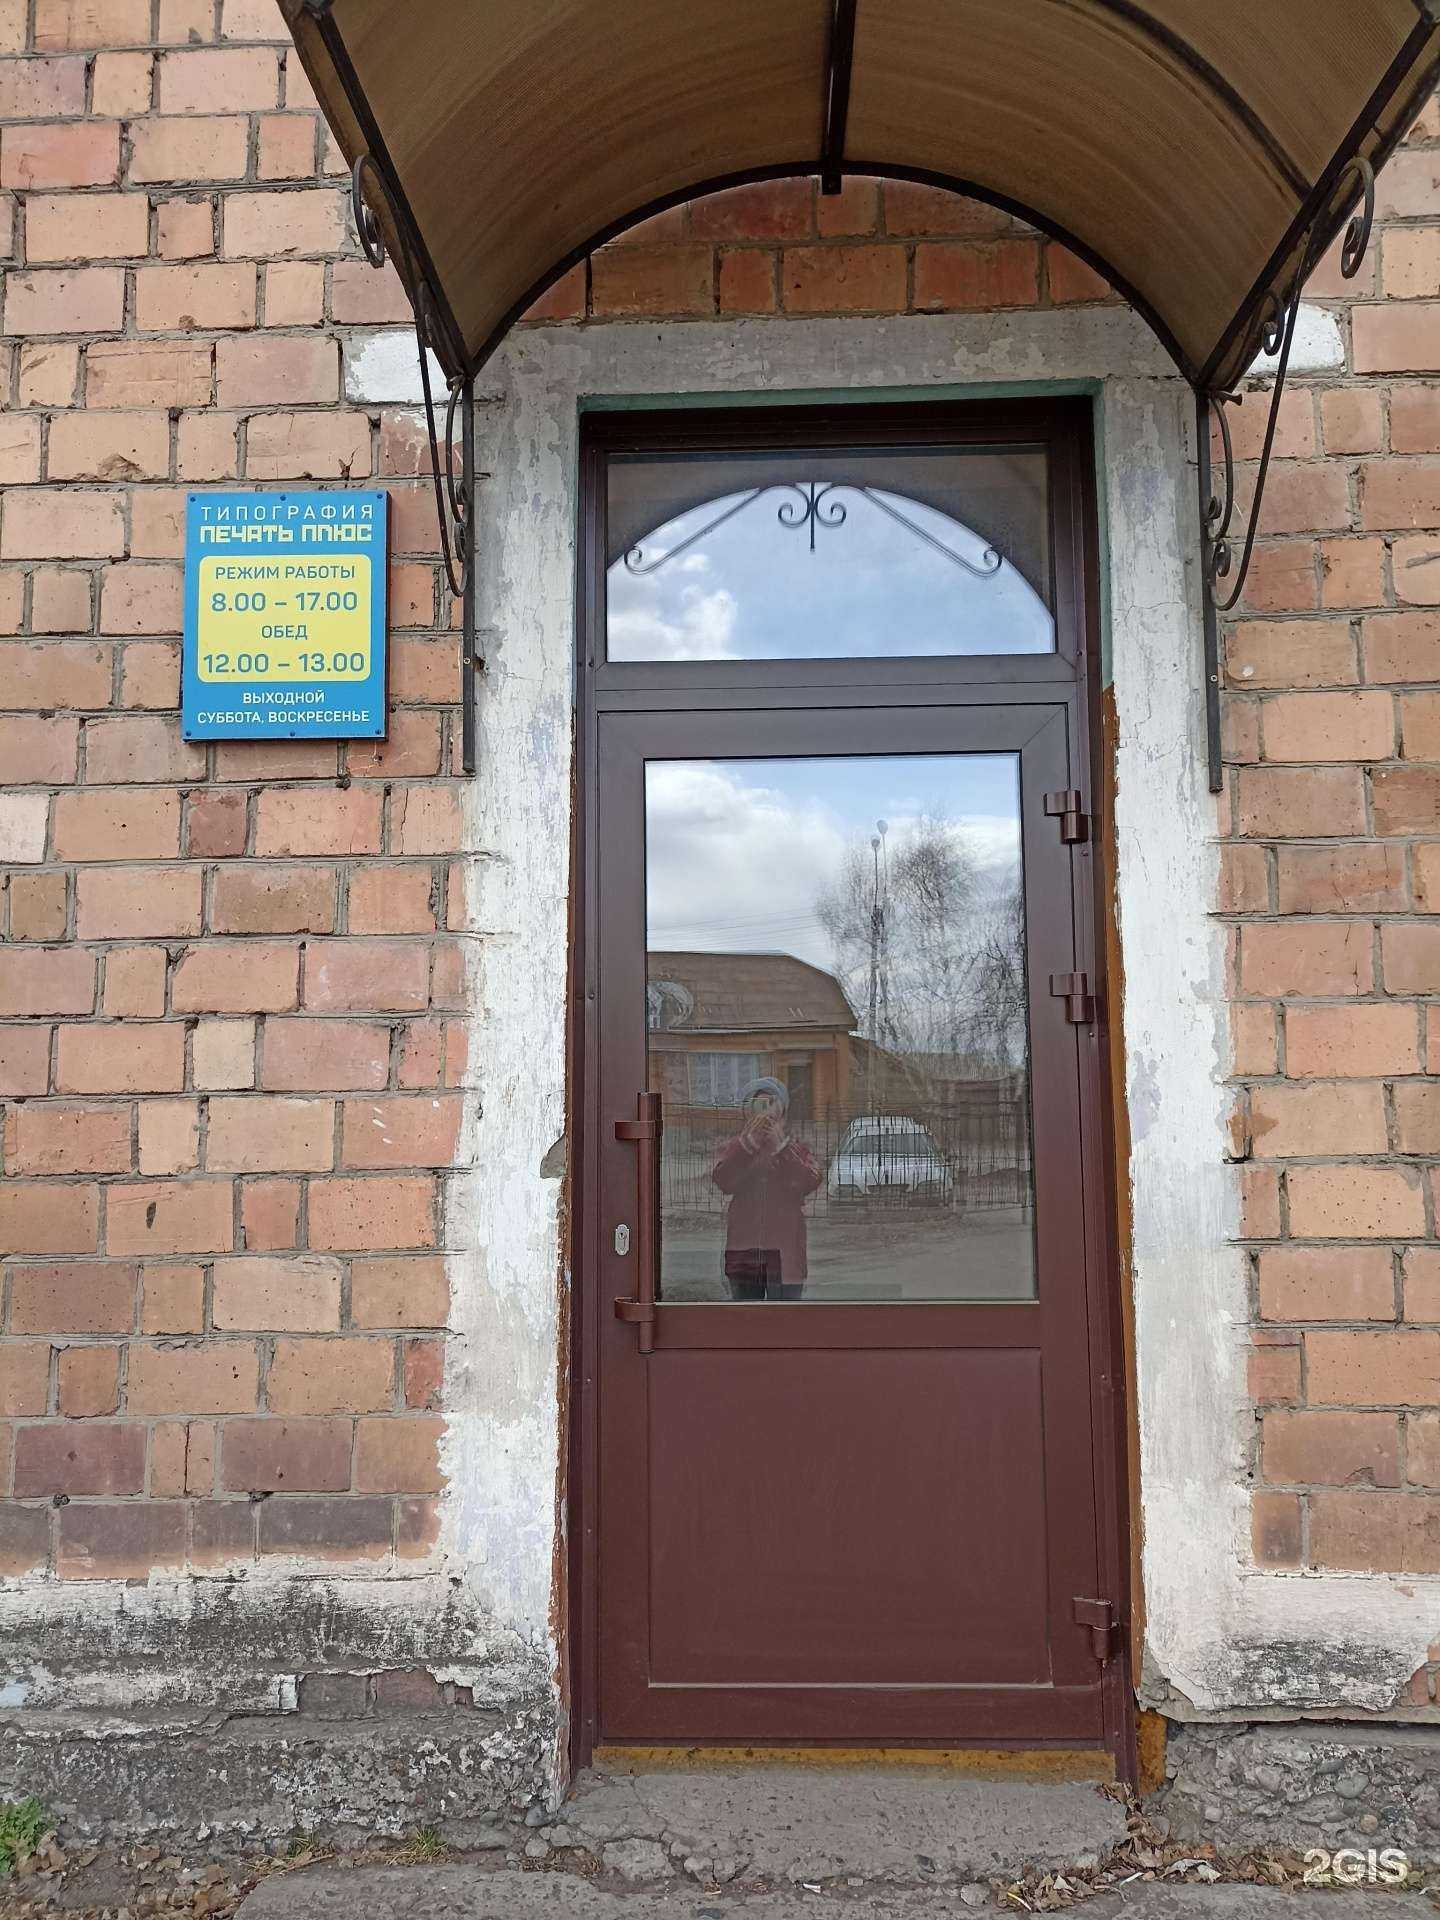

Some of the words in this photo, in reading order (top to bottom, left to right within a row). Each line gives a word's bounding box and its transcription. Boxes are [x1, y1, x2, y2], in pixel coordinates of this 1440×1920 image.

[201, 505, 373, 520] ТИПОГРАФИЯ
[200, 525, 293, 543] ПЕЧАТЬ
[215, 566, 279, 579] РЕЖИМ
[285, 565, 355, 579] РАБОТЫ
[211, 593, 266, 611] 8.00
[295, 592, 358, 611] 17.00
[261, 625, 308, 640] ОБЕД
[203, 653, 269, 673] 12.00
[298, 653, 364, 672] 13.00
[242, 690, 325, 705] ВЫХОДНОЙ
[197, 712, 264, 724] СУББОТА,
[268, 710, 370, 722] ВОСКРЕСЕНЬЕ
